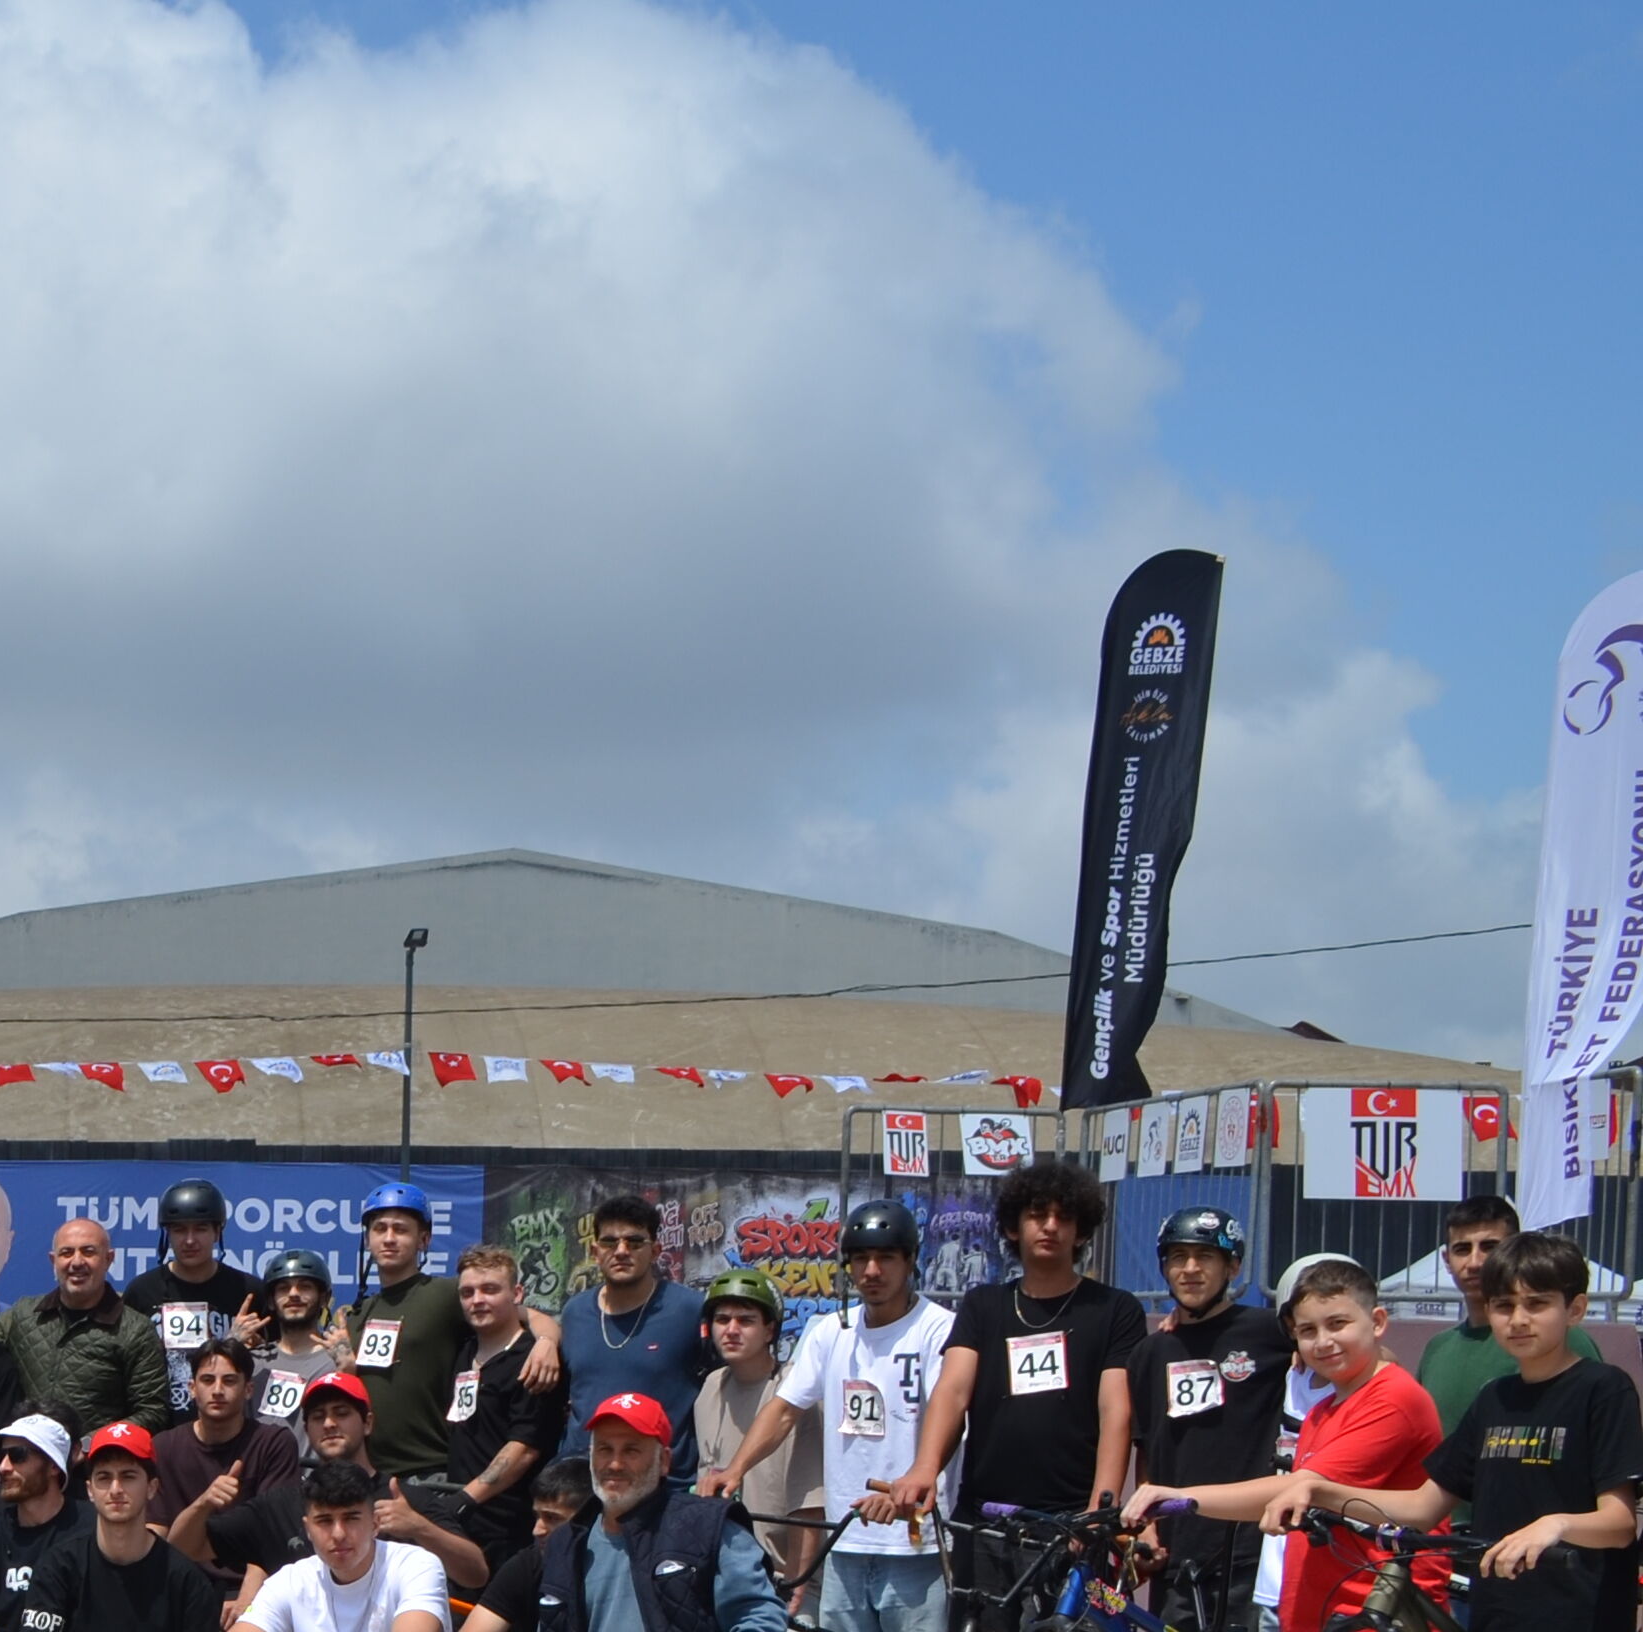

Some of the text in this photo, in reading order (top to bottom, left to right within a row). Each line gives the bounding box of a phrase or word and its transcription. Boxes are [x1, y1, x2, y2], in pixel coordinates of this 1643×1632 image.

[1130, 647, 1185, 664] GEBZE
[1090, 757, 1140, 1079] Gençlik ve Spor Hizmetleri
[1125, 853, 1155, 983] Müdürlüğü
[1547, 906, 1598, 1058] TÜRKİYE
[965, 1136, 1030, 1156] BMX
[1108, 1134, 1125, 1157] UCI
[57, 1196, 158, 1230] TÜM
[514, 1208, 564, 1241] BMX
[690, 1202, 718, 1225] OFF
[688, 1222, 724, 1247] ROAD
[170, 1315, 204, 1336] 94
[364, 1333, 393, 1357] 93
[1018, 1350, 1060, 1378] 44
[266, 1389, 299, 1411] 80
[1176, 1376, 1214, 1406] 87
[849, 1393, 881, 1421] 91
